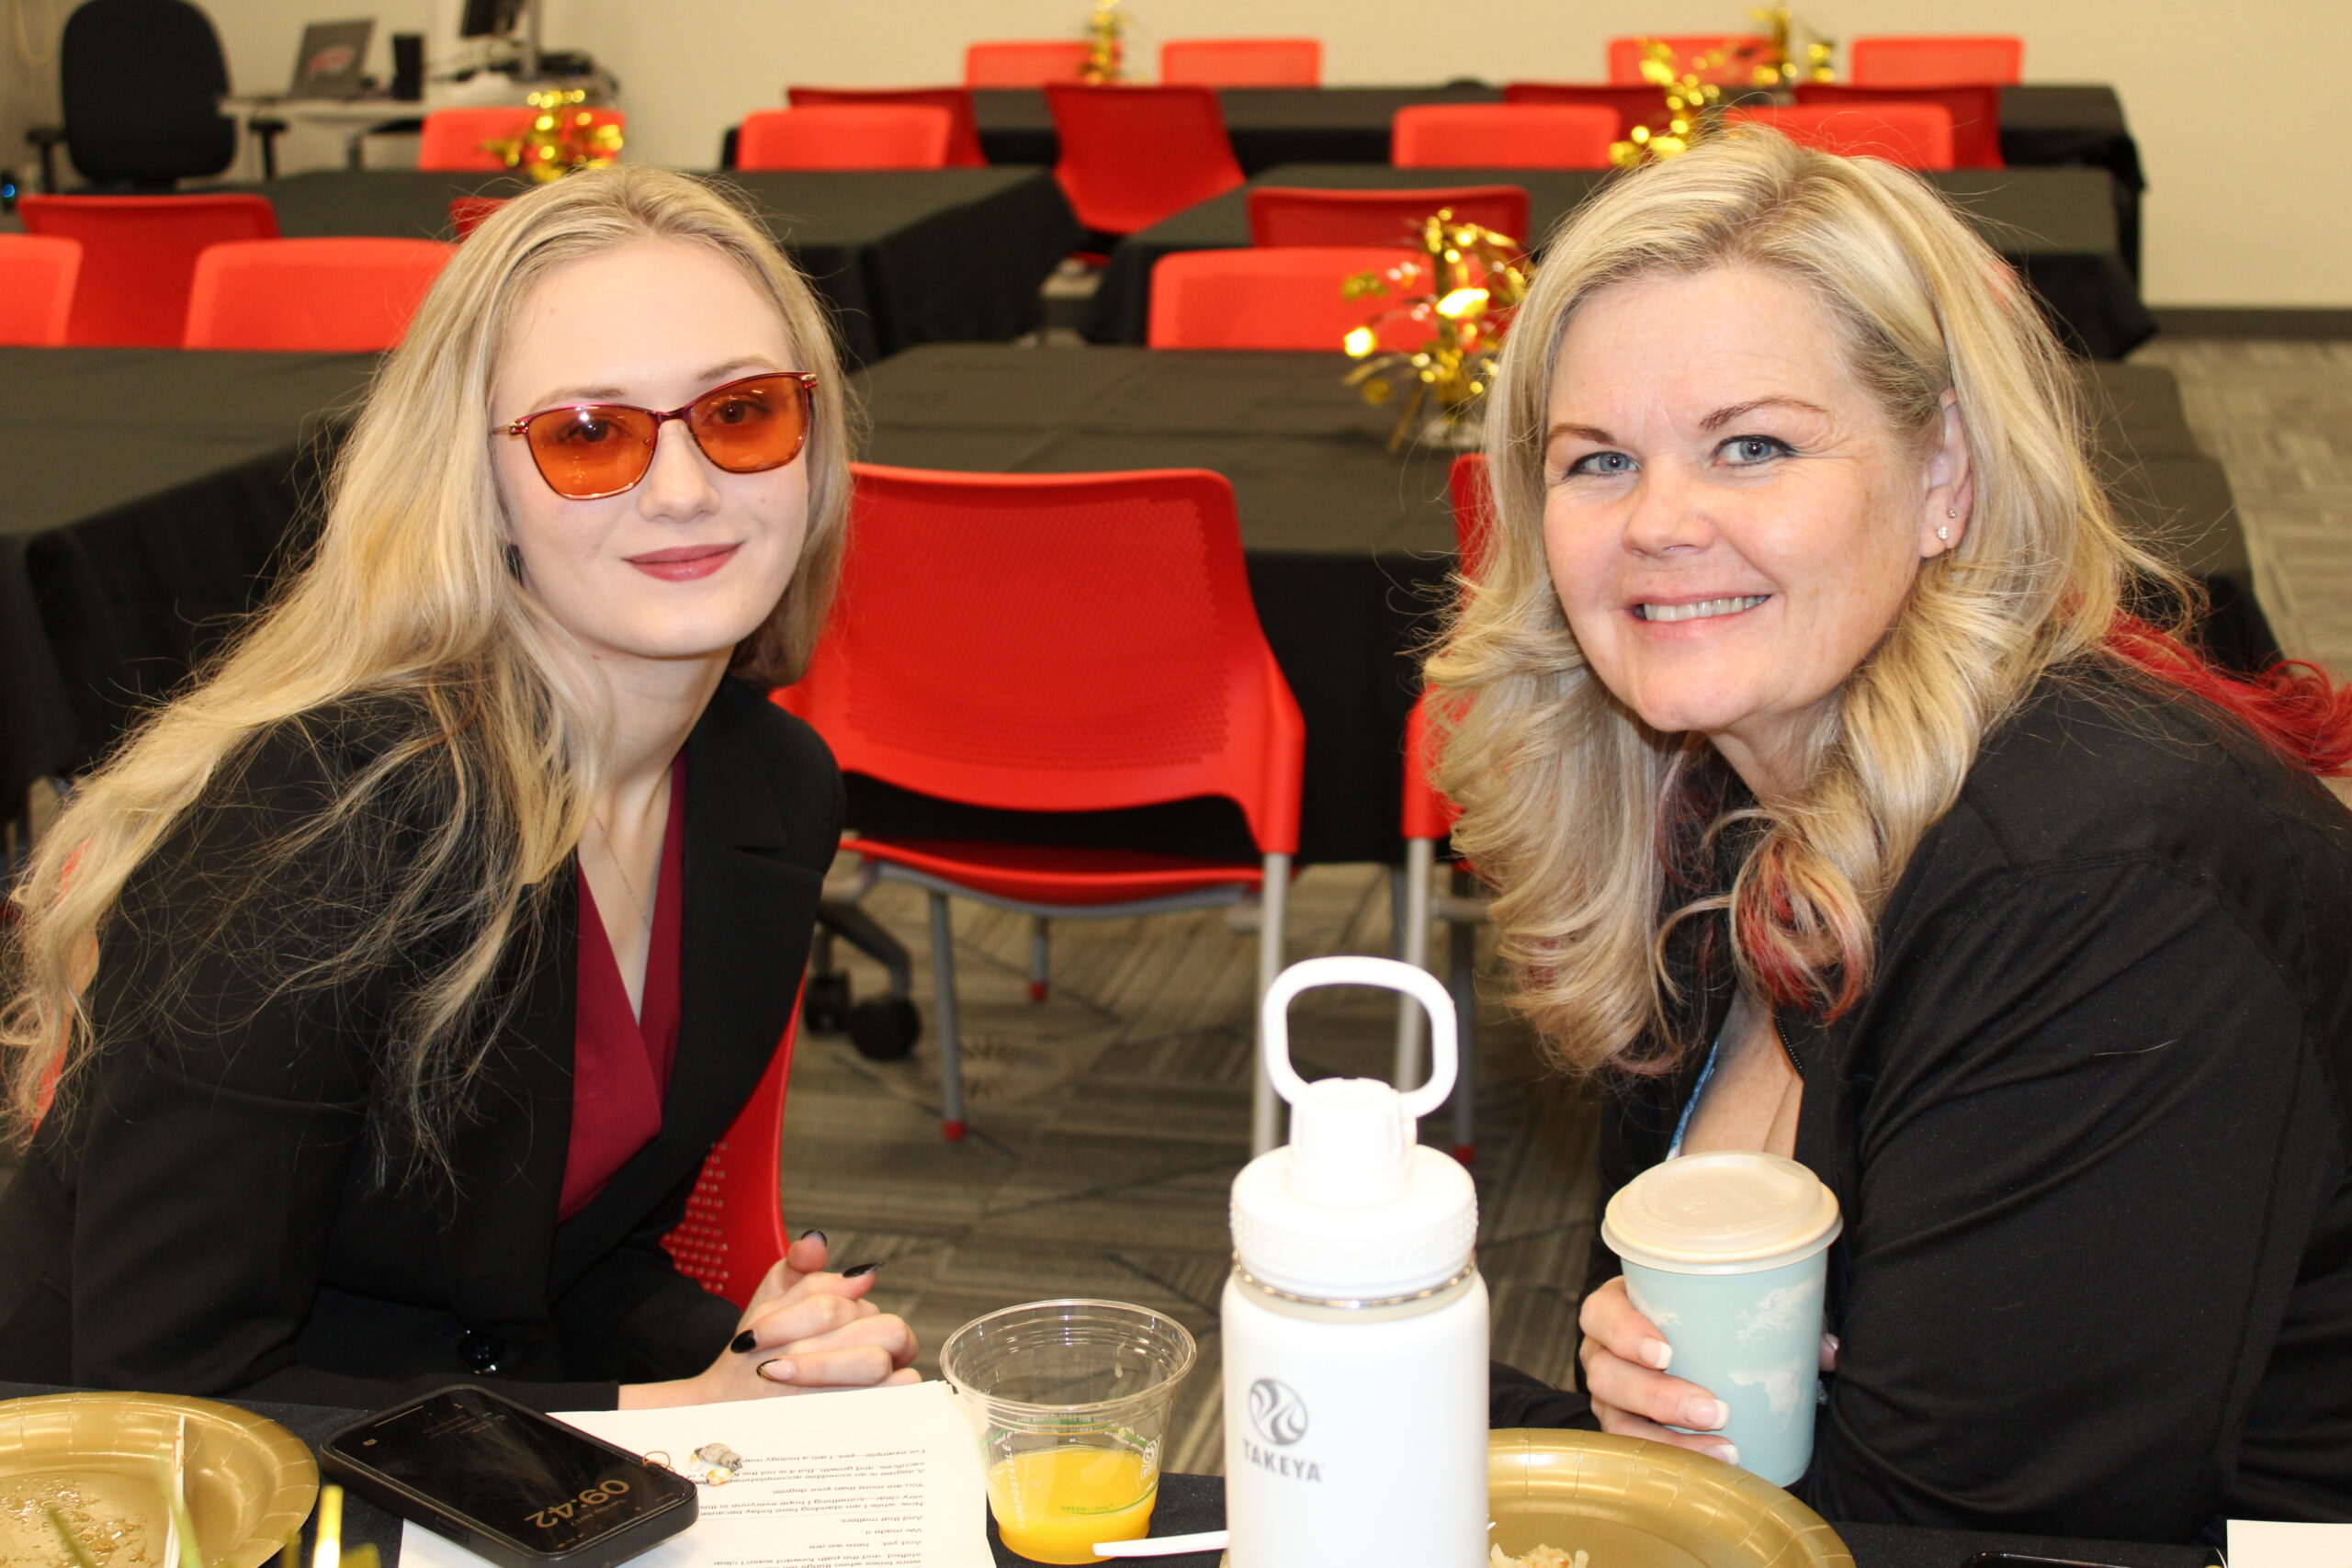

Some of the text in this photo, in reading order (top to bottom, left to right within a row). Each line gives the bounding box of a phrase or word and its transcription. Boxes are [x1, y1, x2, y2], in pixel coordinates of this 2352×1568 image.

[880, 1469, 915, 1477] degree
[1242, 1438, 1323, 1483] TAKEYA
[524, 1479, 630, 1529] 09:42
[1002, 1443, 1026, 1529] COMPOSTABLE
